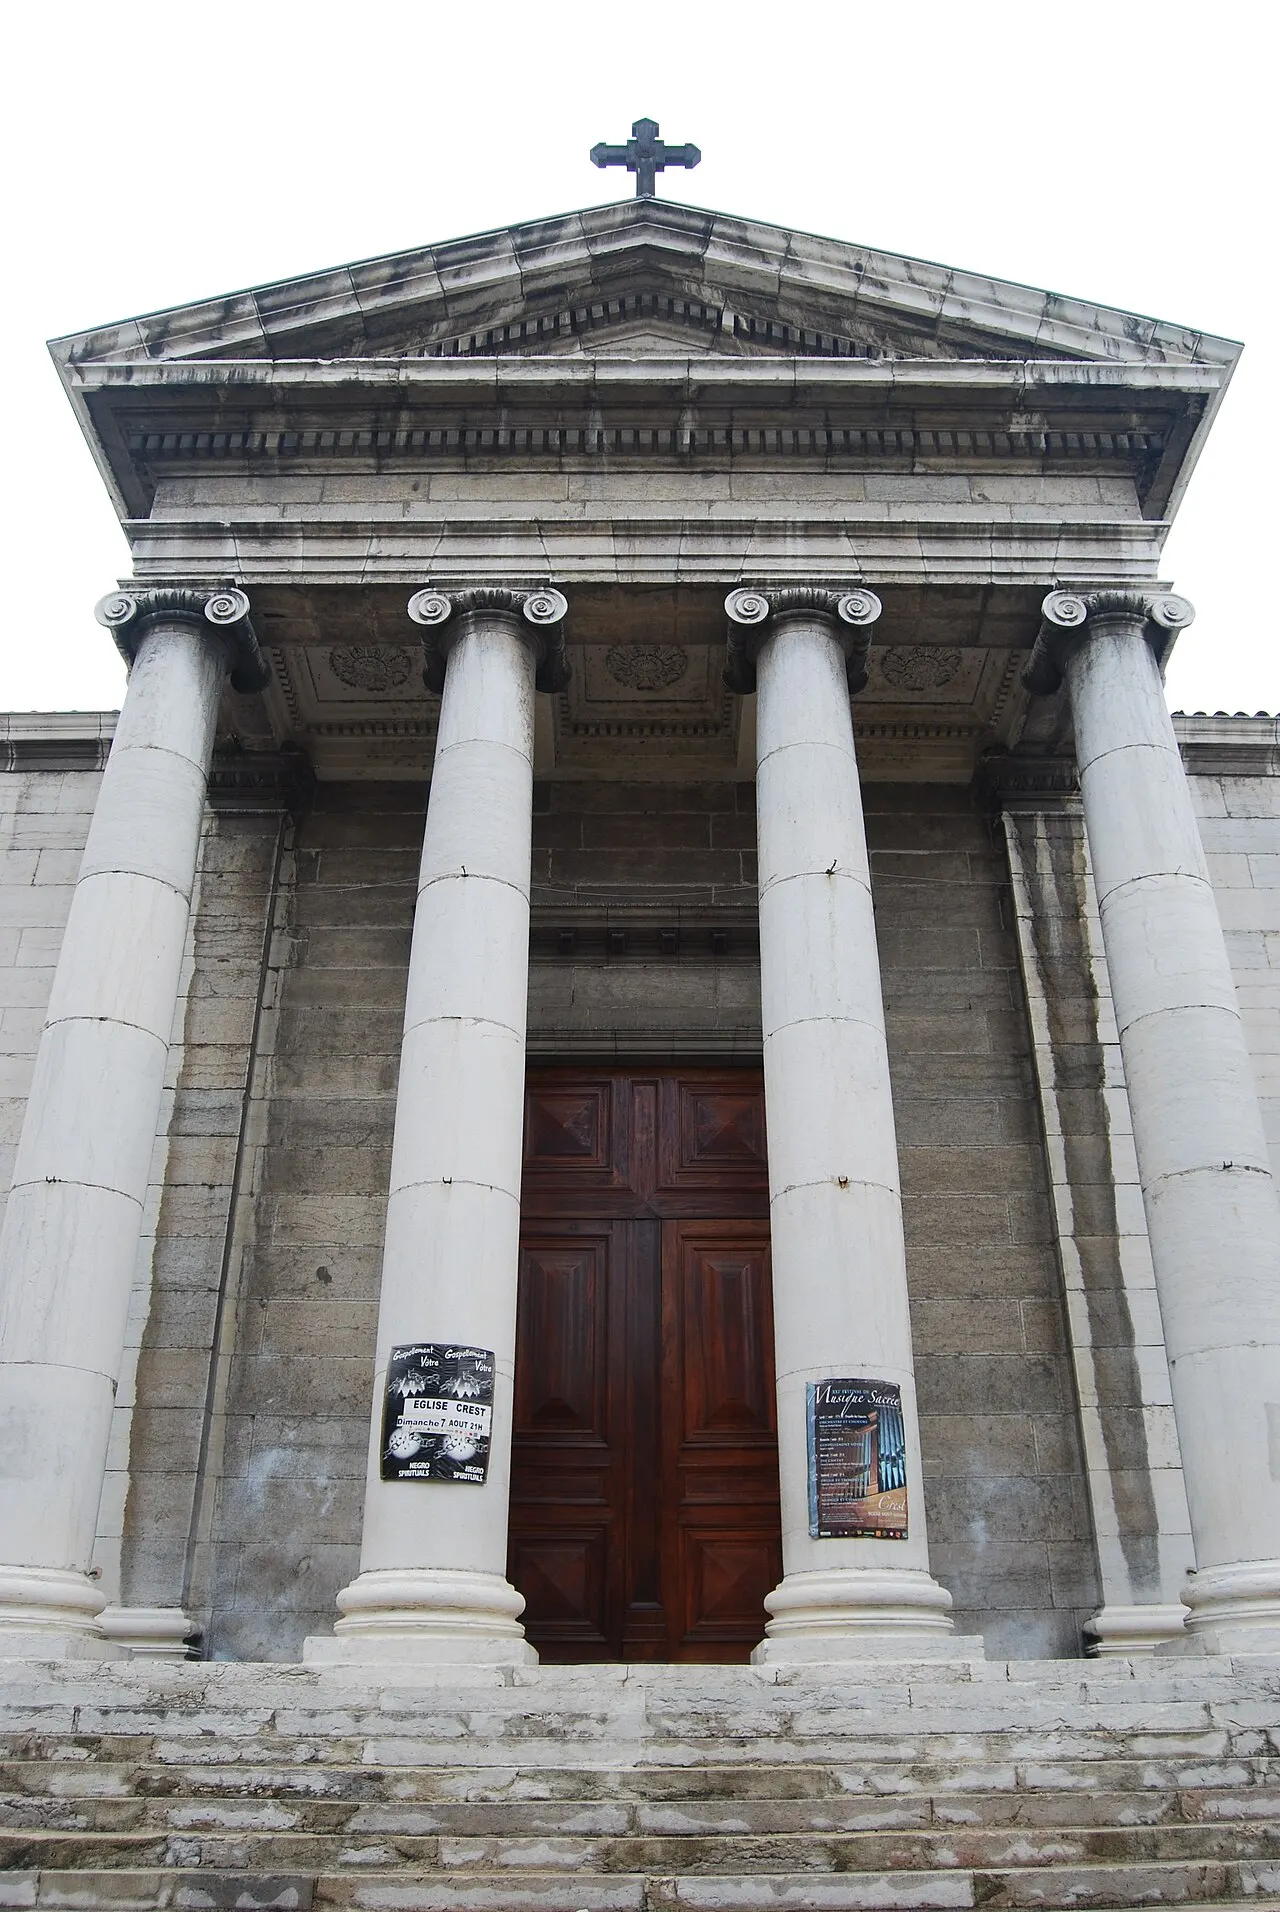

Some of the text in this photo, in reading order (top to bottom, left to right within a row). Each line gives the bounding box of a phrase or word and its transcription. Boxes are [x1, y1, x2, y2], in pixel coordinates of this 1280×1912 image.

[420, 1355, 439, 1367] Vôtre
[475, 1360, 492, 1373] Vôtre
[807, 1385, 900, 1418] Musique Sacrée
[413, 1400, 486, 1417] EGLISE CREST
[397, 1418, 483, 1431] Dimanche 7 AOUT 21H
[409, 1462, 431, 1470] NEGRO
[878, 1495, 906, 1511] Crest
